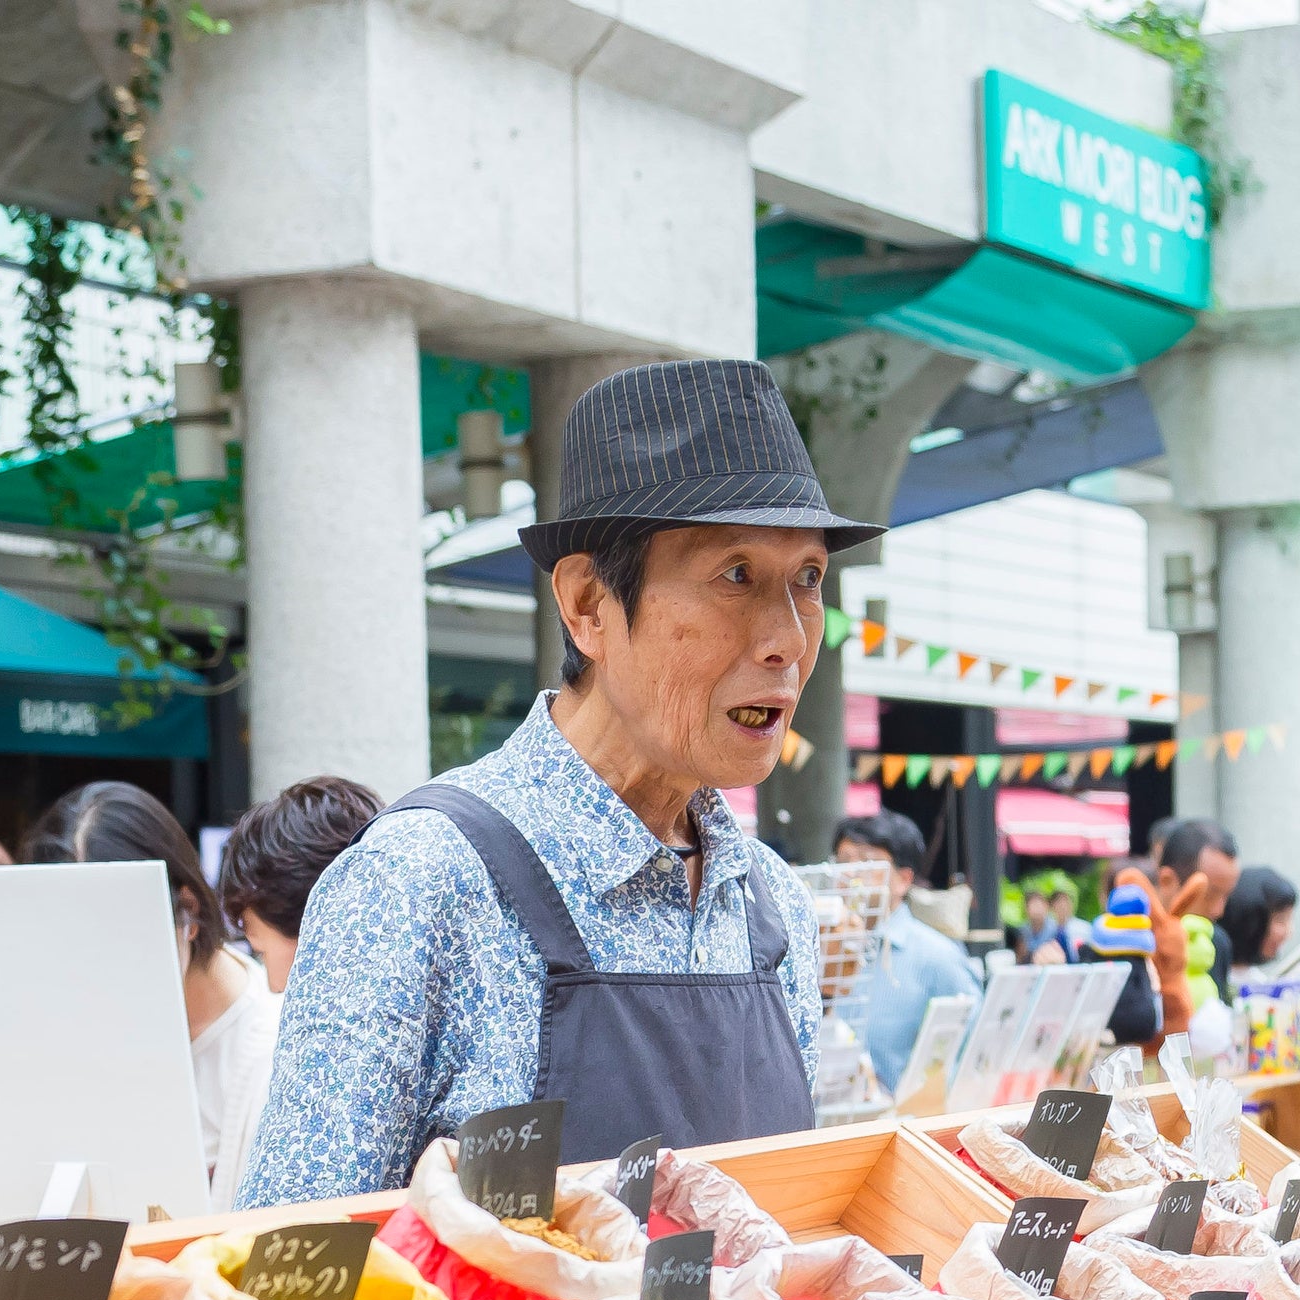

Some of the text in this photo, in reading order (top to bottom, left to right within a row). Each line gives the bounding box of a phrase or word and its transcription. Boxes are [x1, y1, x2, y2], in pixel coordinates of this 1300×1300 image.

[1003, 102, 1064, 188] ARK
[1061, 123, 1137, 216] MORI
[1060, 199, 1163, 275] WEST
